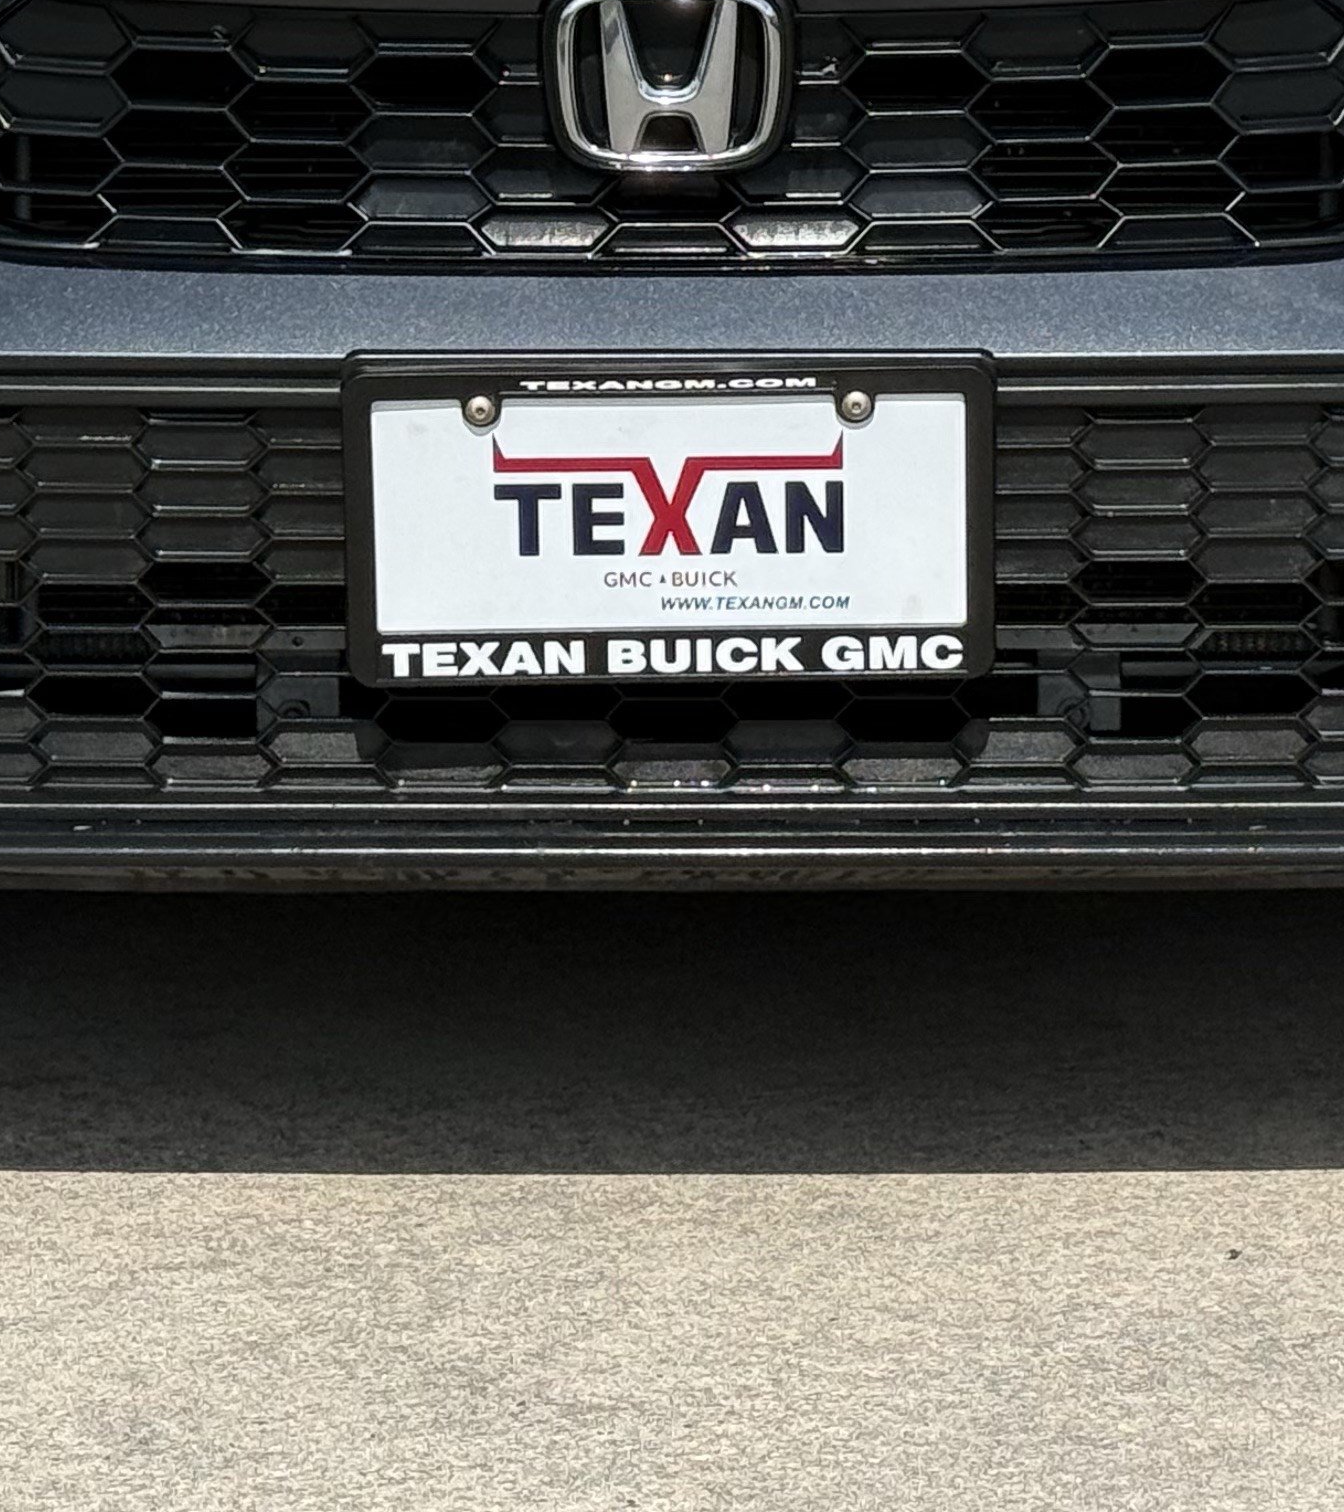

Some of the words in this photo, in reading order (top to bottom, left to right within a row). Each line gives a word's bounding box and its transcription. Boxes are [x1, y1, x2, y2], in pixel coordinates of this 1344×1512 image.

[518, 376, 818, 392] TEXANGM.COM
[493, 456, 845, 556] TEXAN
[604, 570, 653, 588] GMC
[671, 570, 738, 588] BUICK
[660, 594, 851, 612] WWW.TEXANGM.COM
[381, 642, 586, 678] TEXAN
[606, 638, 805, 674] BUICK
[821, 634, 964, 672] GMC
